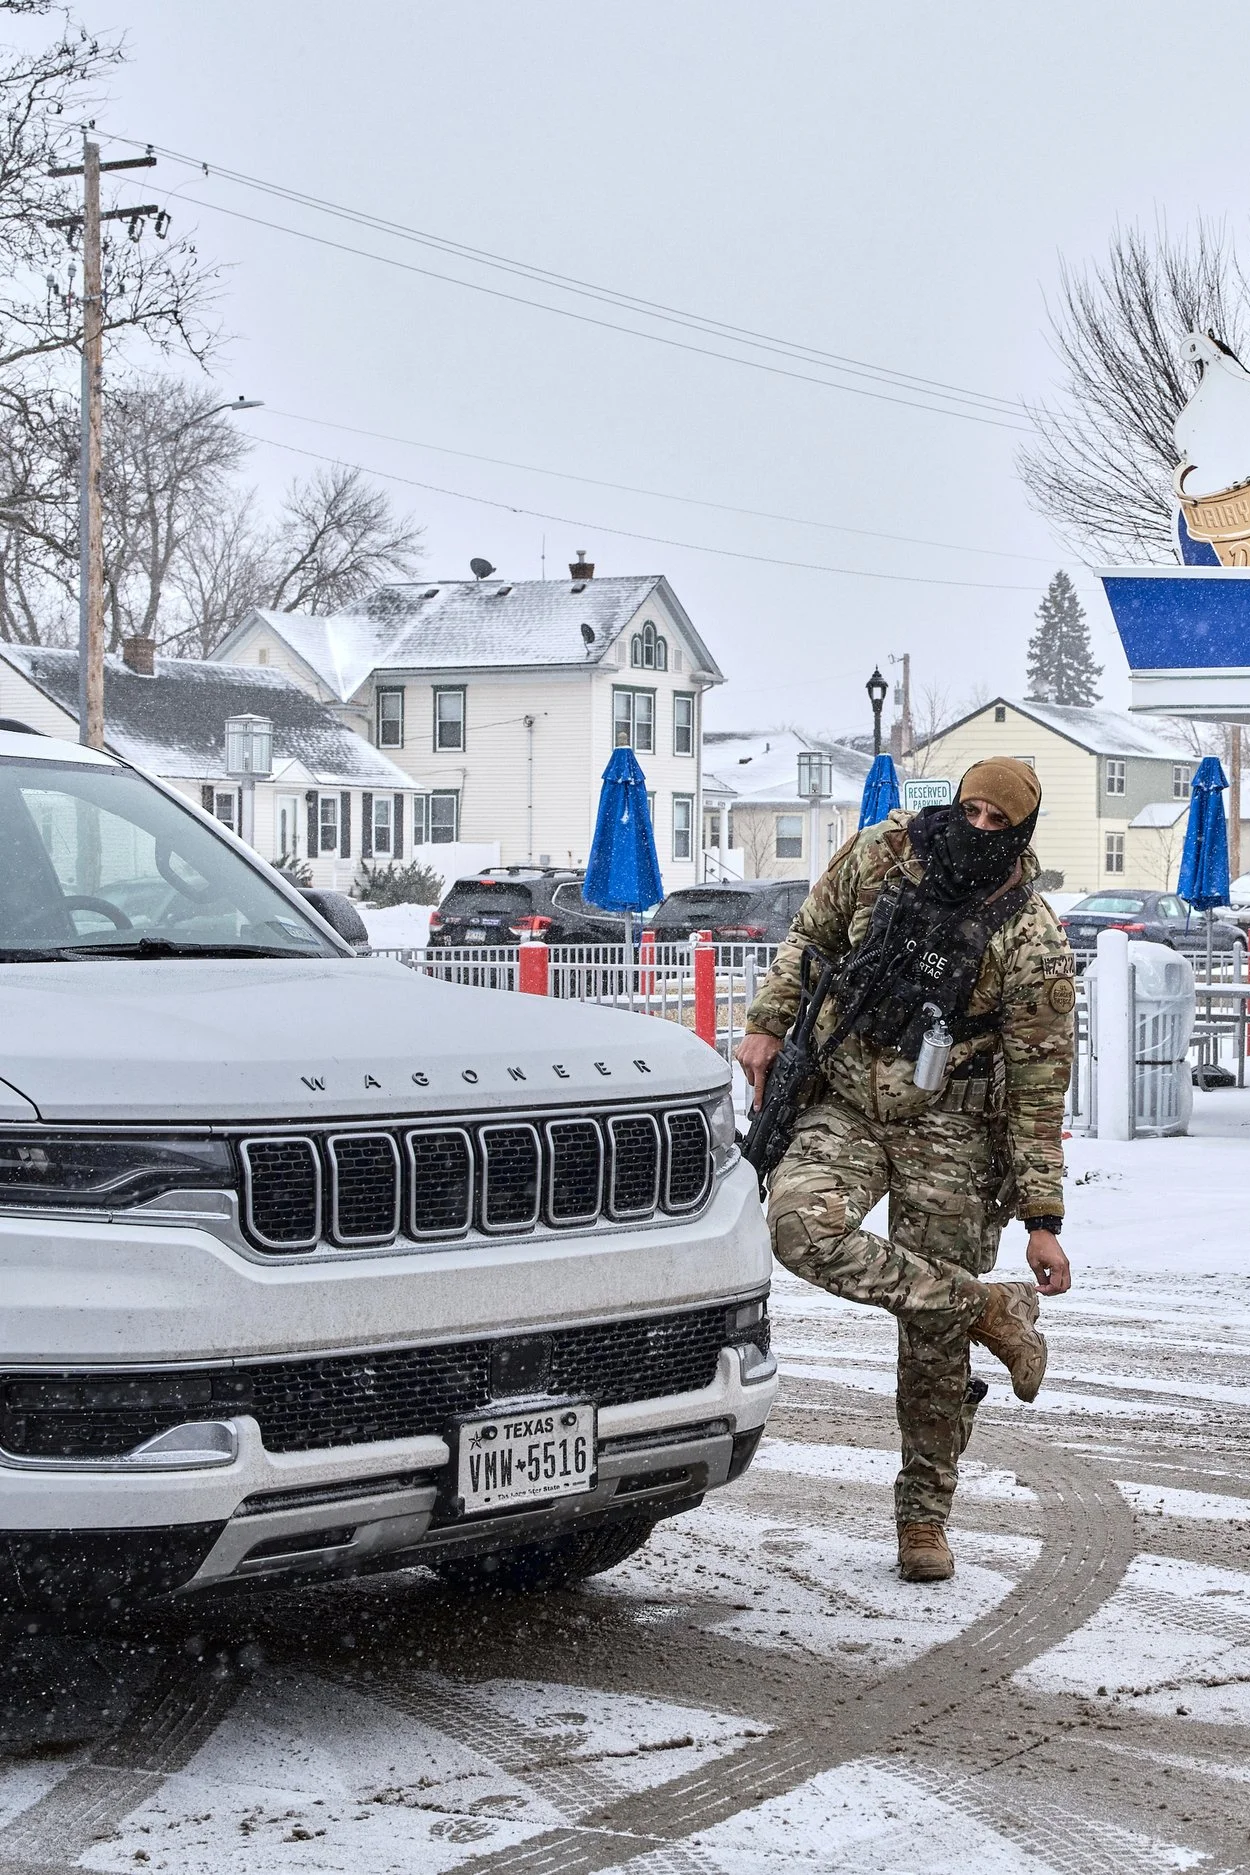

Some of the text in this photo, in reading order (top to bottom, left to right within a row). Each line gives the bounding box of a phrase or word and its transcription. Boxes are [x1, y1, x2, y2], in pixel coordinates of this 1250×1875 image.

[1189, 500, 1250, 529] DAIRY
[908, 786, 948, 799] RESERVED
[300, 1058, 652, 1091] WAGONEER
[503, 1417, 554, 1440] TEXAS
